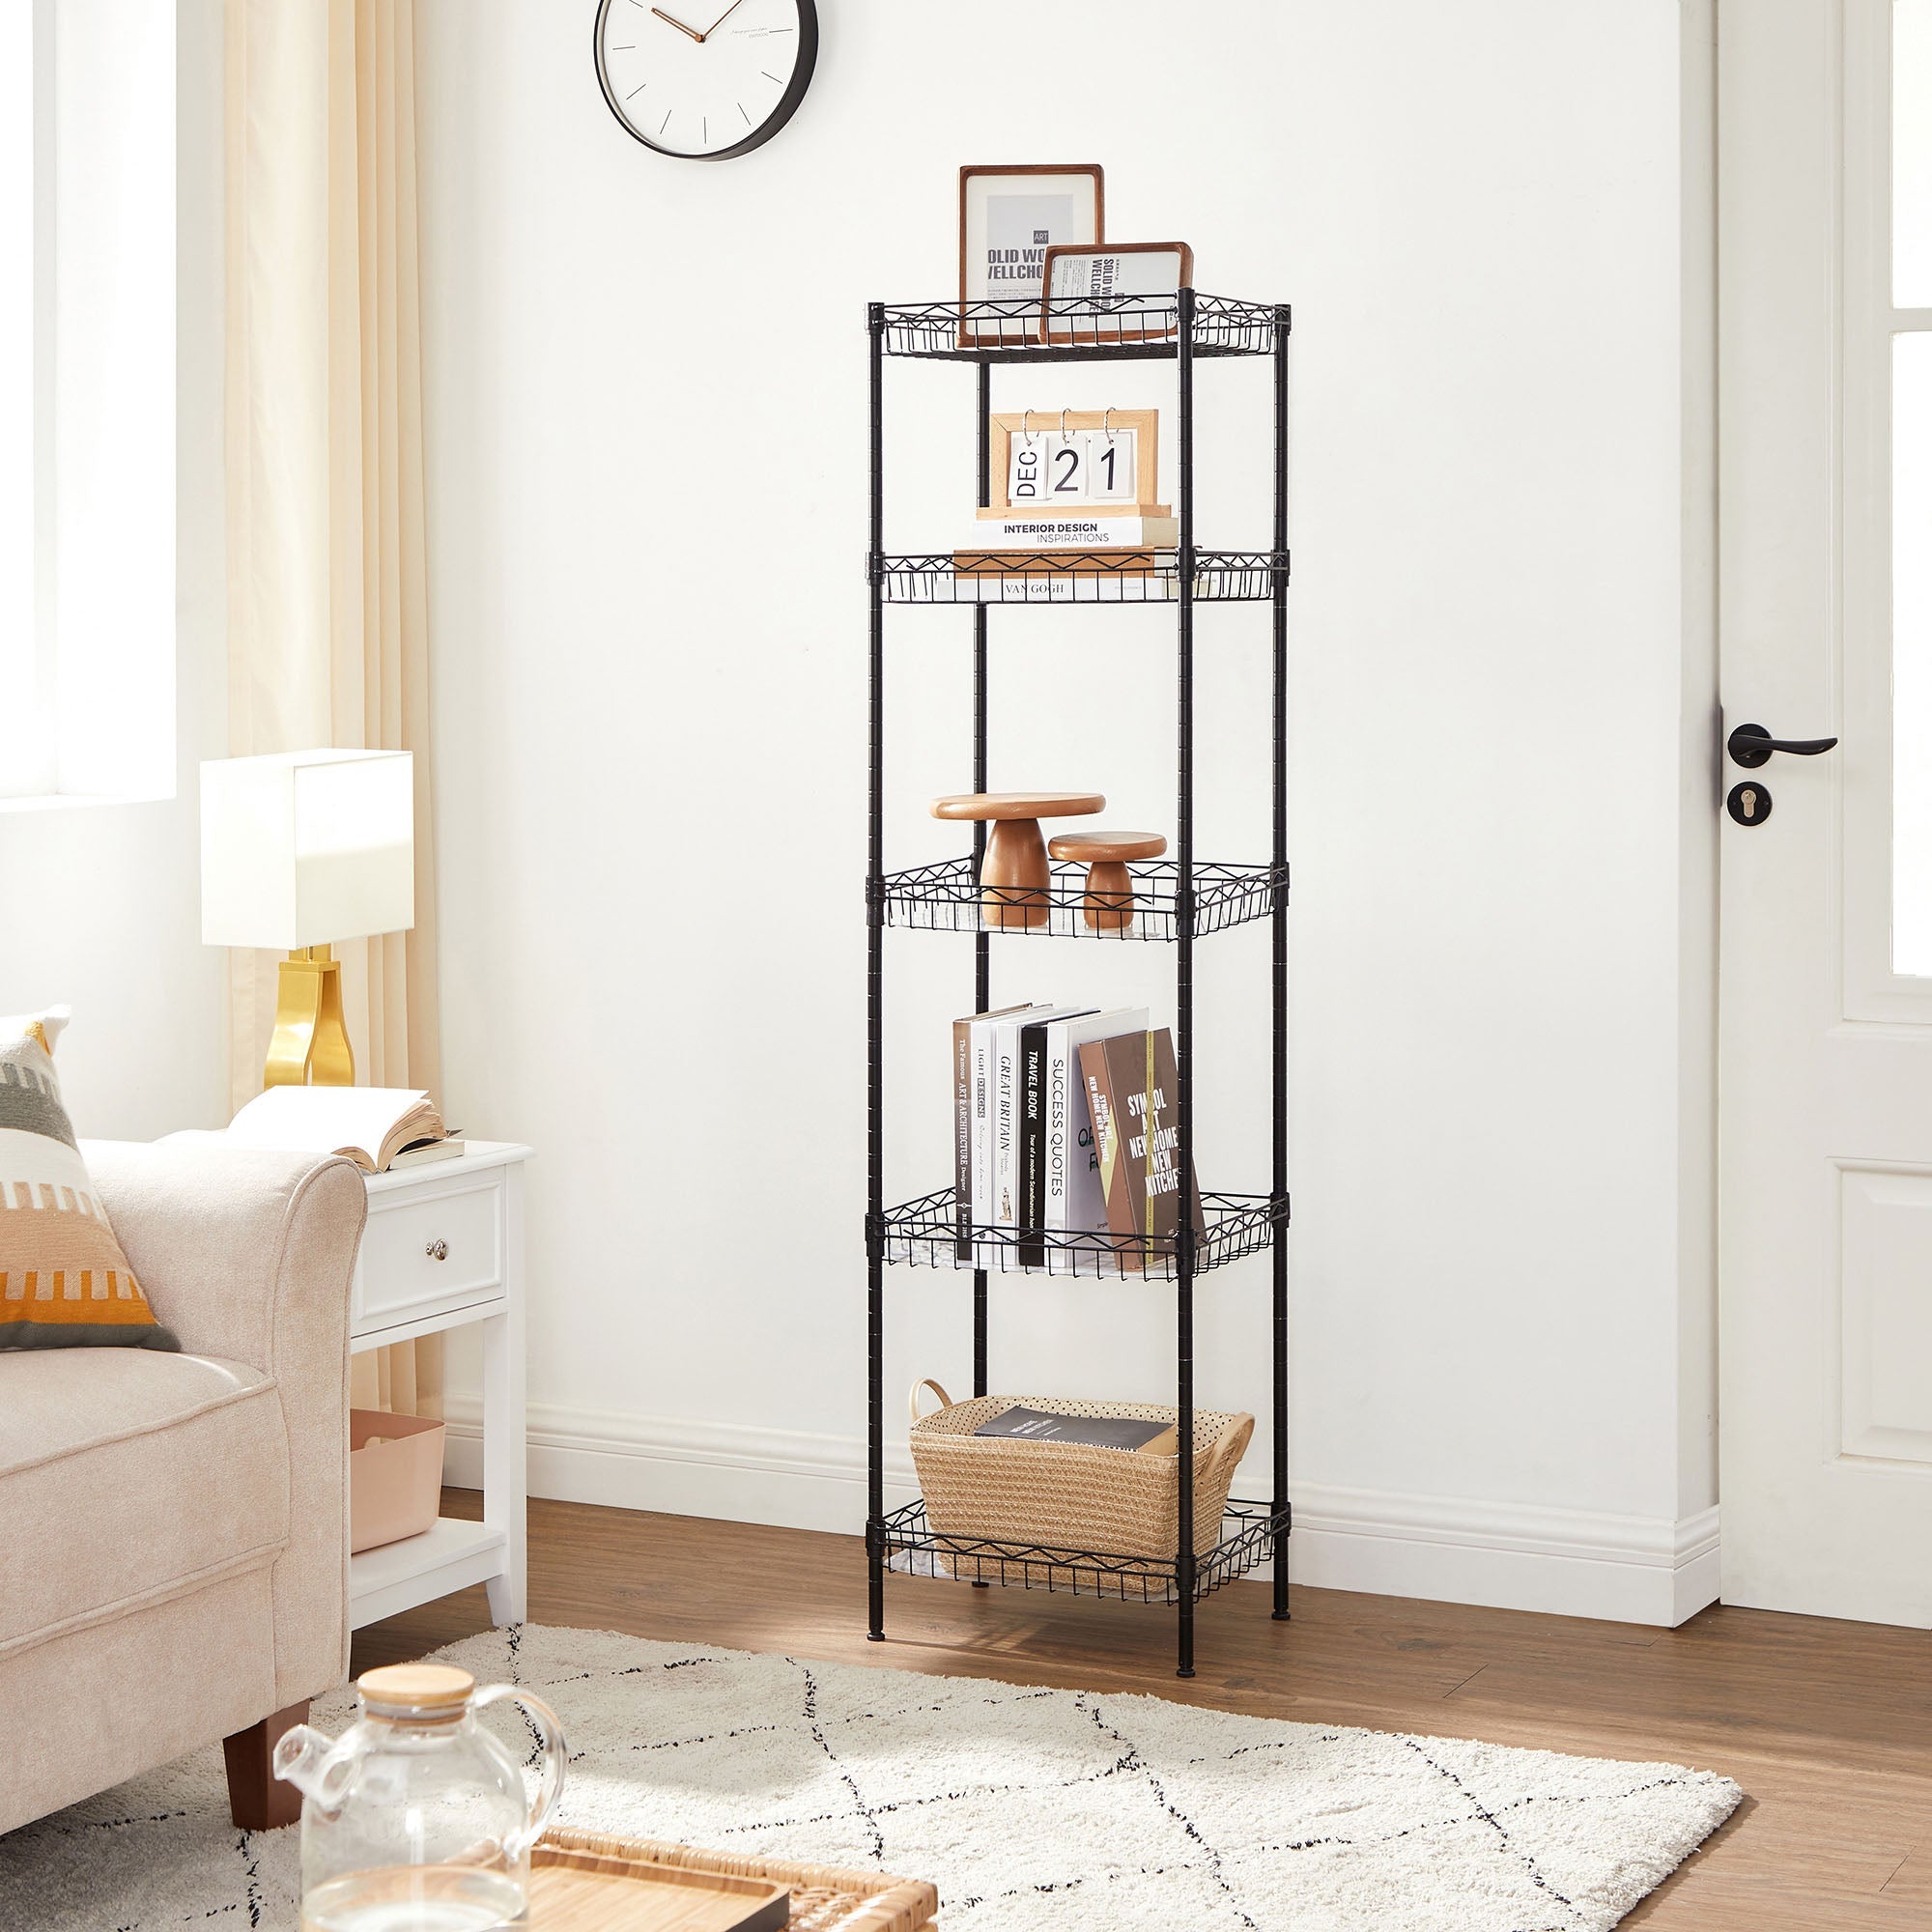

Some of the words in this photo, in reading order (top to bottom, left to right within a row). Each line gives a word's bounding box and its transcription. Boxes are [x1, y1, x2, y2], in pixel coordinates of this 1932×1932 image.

[1034, 232, 1048, 242] ART
[987, 248, 1020, 264] OLID
[1022, 247, 1045, 263] WO
[987, 264, 1044, 280] ELLCHO
[1102, 258, 1115, 285] SOLID
[1016, 450, 1038, 497] DEC
[1004, 524, 1056, 534] INTERIOR
[1057, 523, 1098, 533] DESIGN
[1037, 532, 1110, 543] INSPIRATIONS
[1006, 583, 1027, 594] VAN
[1031, 583, 1065, 594] GOGH
[1000, 1056, 1011, 1098] GREAT
[1028, 1050, 1038, 1088] TRAVEL
[958, 1082, 967, 1099] ART
[1052, 1058, 1065, 1128] SUCCESS
[1088, 1075, 1098, 1092] NEW
[1027, 1090, 1038, 1120] BOOK
[1092, 1093, 1101, 1115] HOME
[1098, 1094, 1111, 1125] SYMBOL
[1127, 1088, 1167, 1117] SYMOL
[959, 1105, 969, 1166] ARCHITECTURE
[999, 1099, 1010, 1151] BRITAIN
[1095, 1115, 1104, 1131] NEW
[1141, 1110, 1160, 1135] AT
[1098, 1131, 1110, 1163] KITCHEN
[1050, 1132, 1064, 1197] QUOTES
[1151, 1149, 1173, 1174] NEW
[1145, 1168, 1179, 1197] KITCHE
